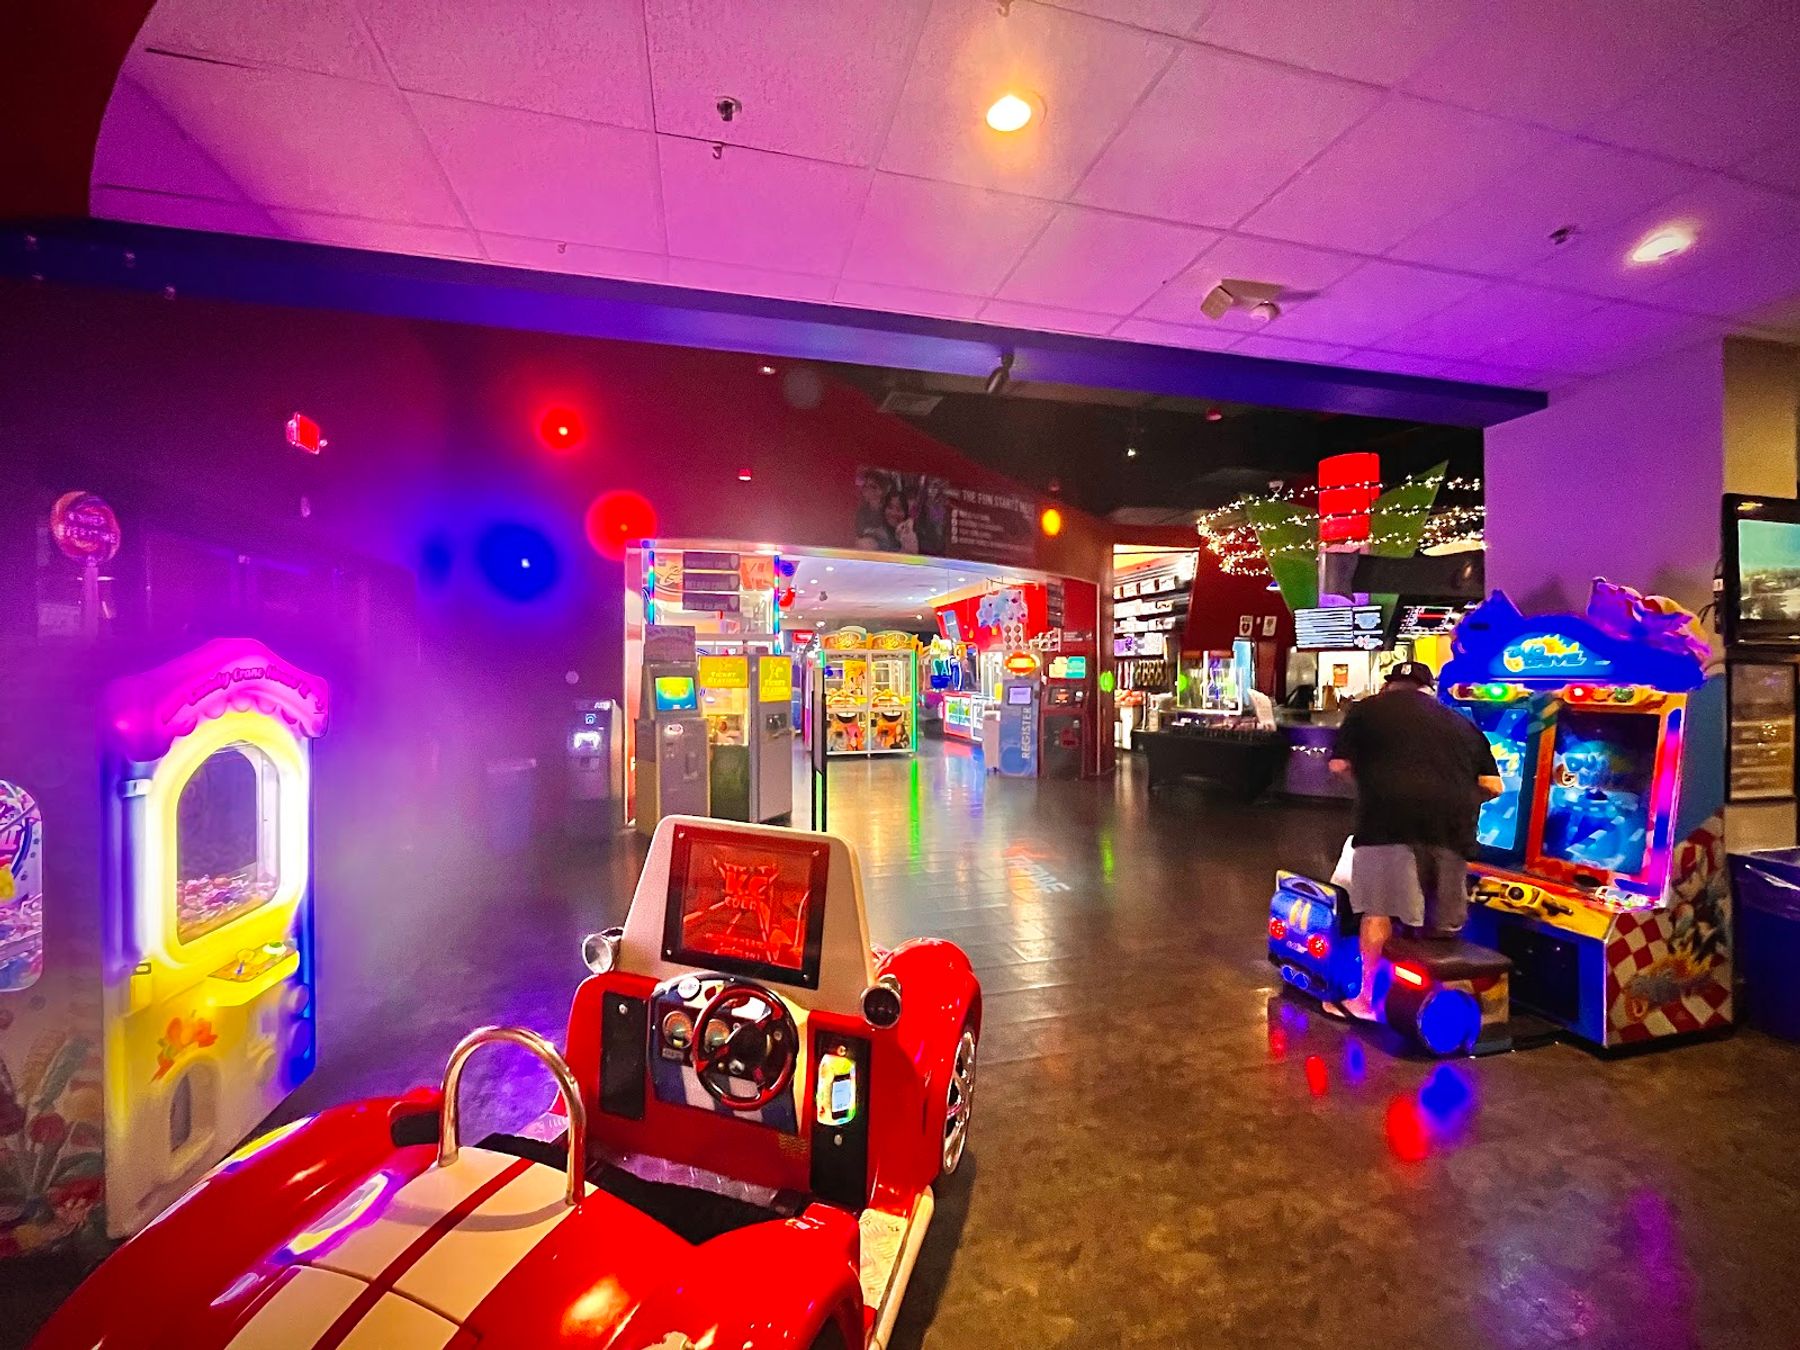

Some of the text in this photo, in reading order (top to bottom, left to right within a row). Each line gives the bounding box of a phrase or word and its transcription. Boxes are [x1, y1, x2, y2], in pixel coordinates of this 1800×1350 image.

[232, 668, 264, 682] Crane
[711, 671, 737, 679] TICKET
[1021, 706, 1032, 759] REGISTER
